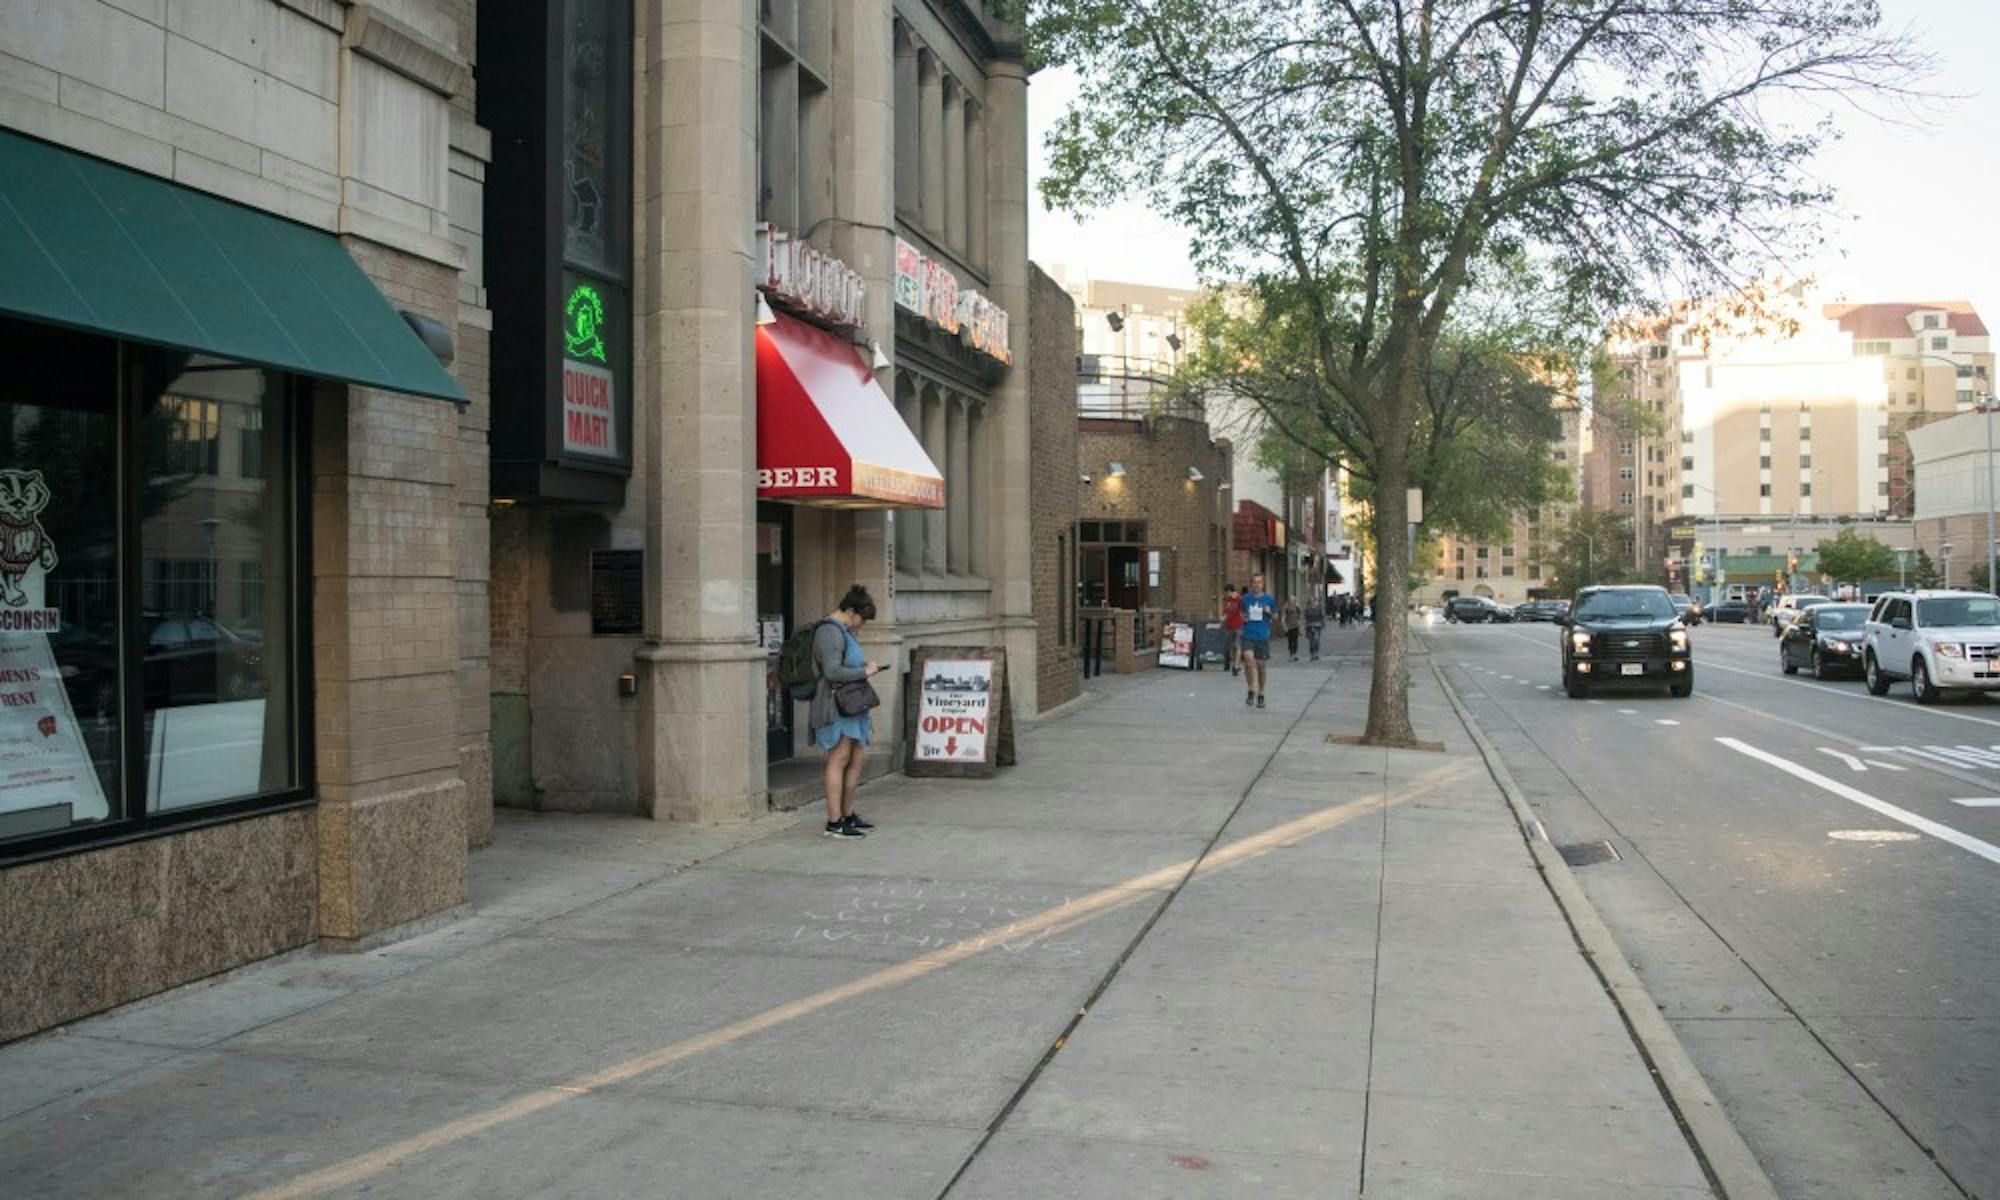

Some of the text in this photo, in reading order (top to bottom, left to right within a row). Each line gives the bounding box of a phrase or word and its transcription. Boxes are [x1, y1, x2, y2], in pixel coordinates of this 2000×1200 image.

[565, 370, 608, 410] QUICK
[568, 410, 608, 448] MART
[757, 467, 838, 488] BEER
[922, 715, 985, 734] OPEN
